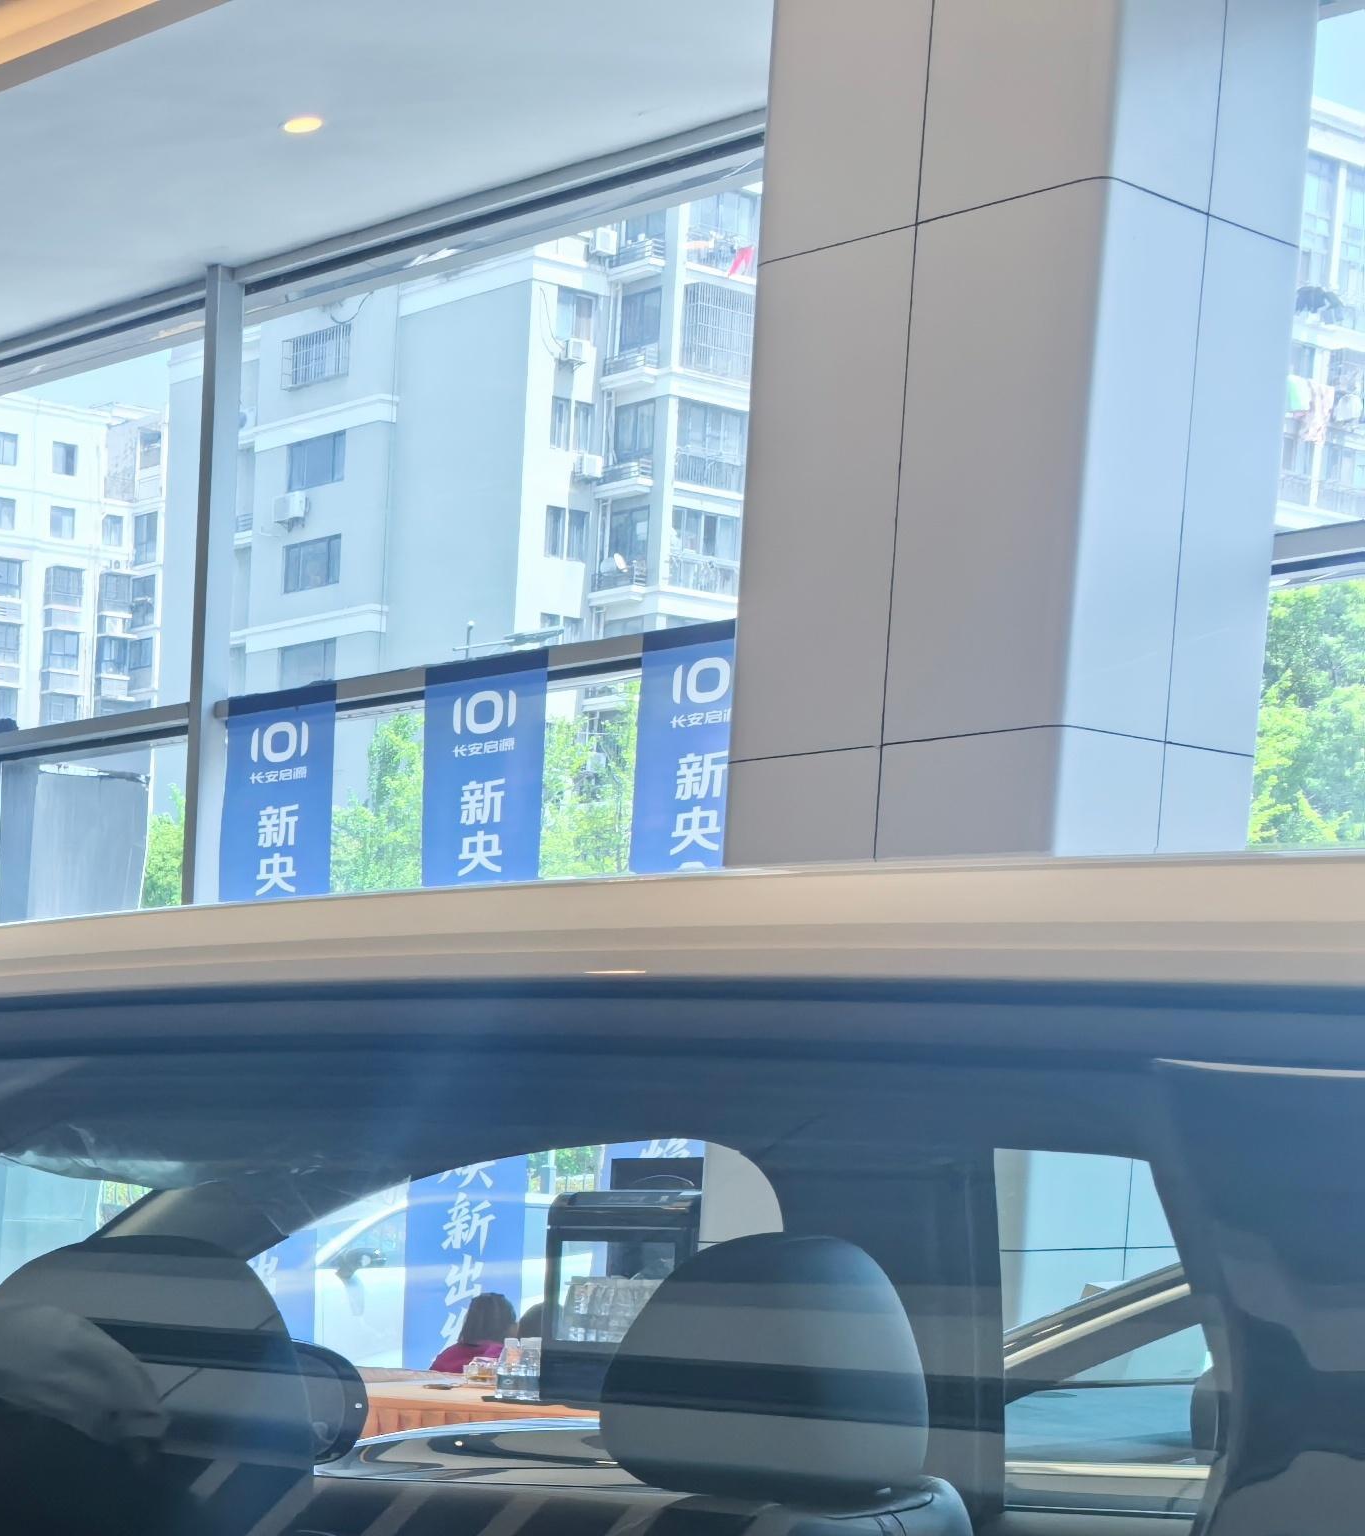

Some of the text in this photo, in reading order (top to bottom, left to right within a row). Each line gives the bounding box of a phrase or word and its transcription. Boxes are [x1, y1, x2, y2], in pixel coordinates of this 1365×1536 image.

[452, 737, 516, 759] 长安启源
[249, 765, 308, 785] 长安启源
